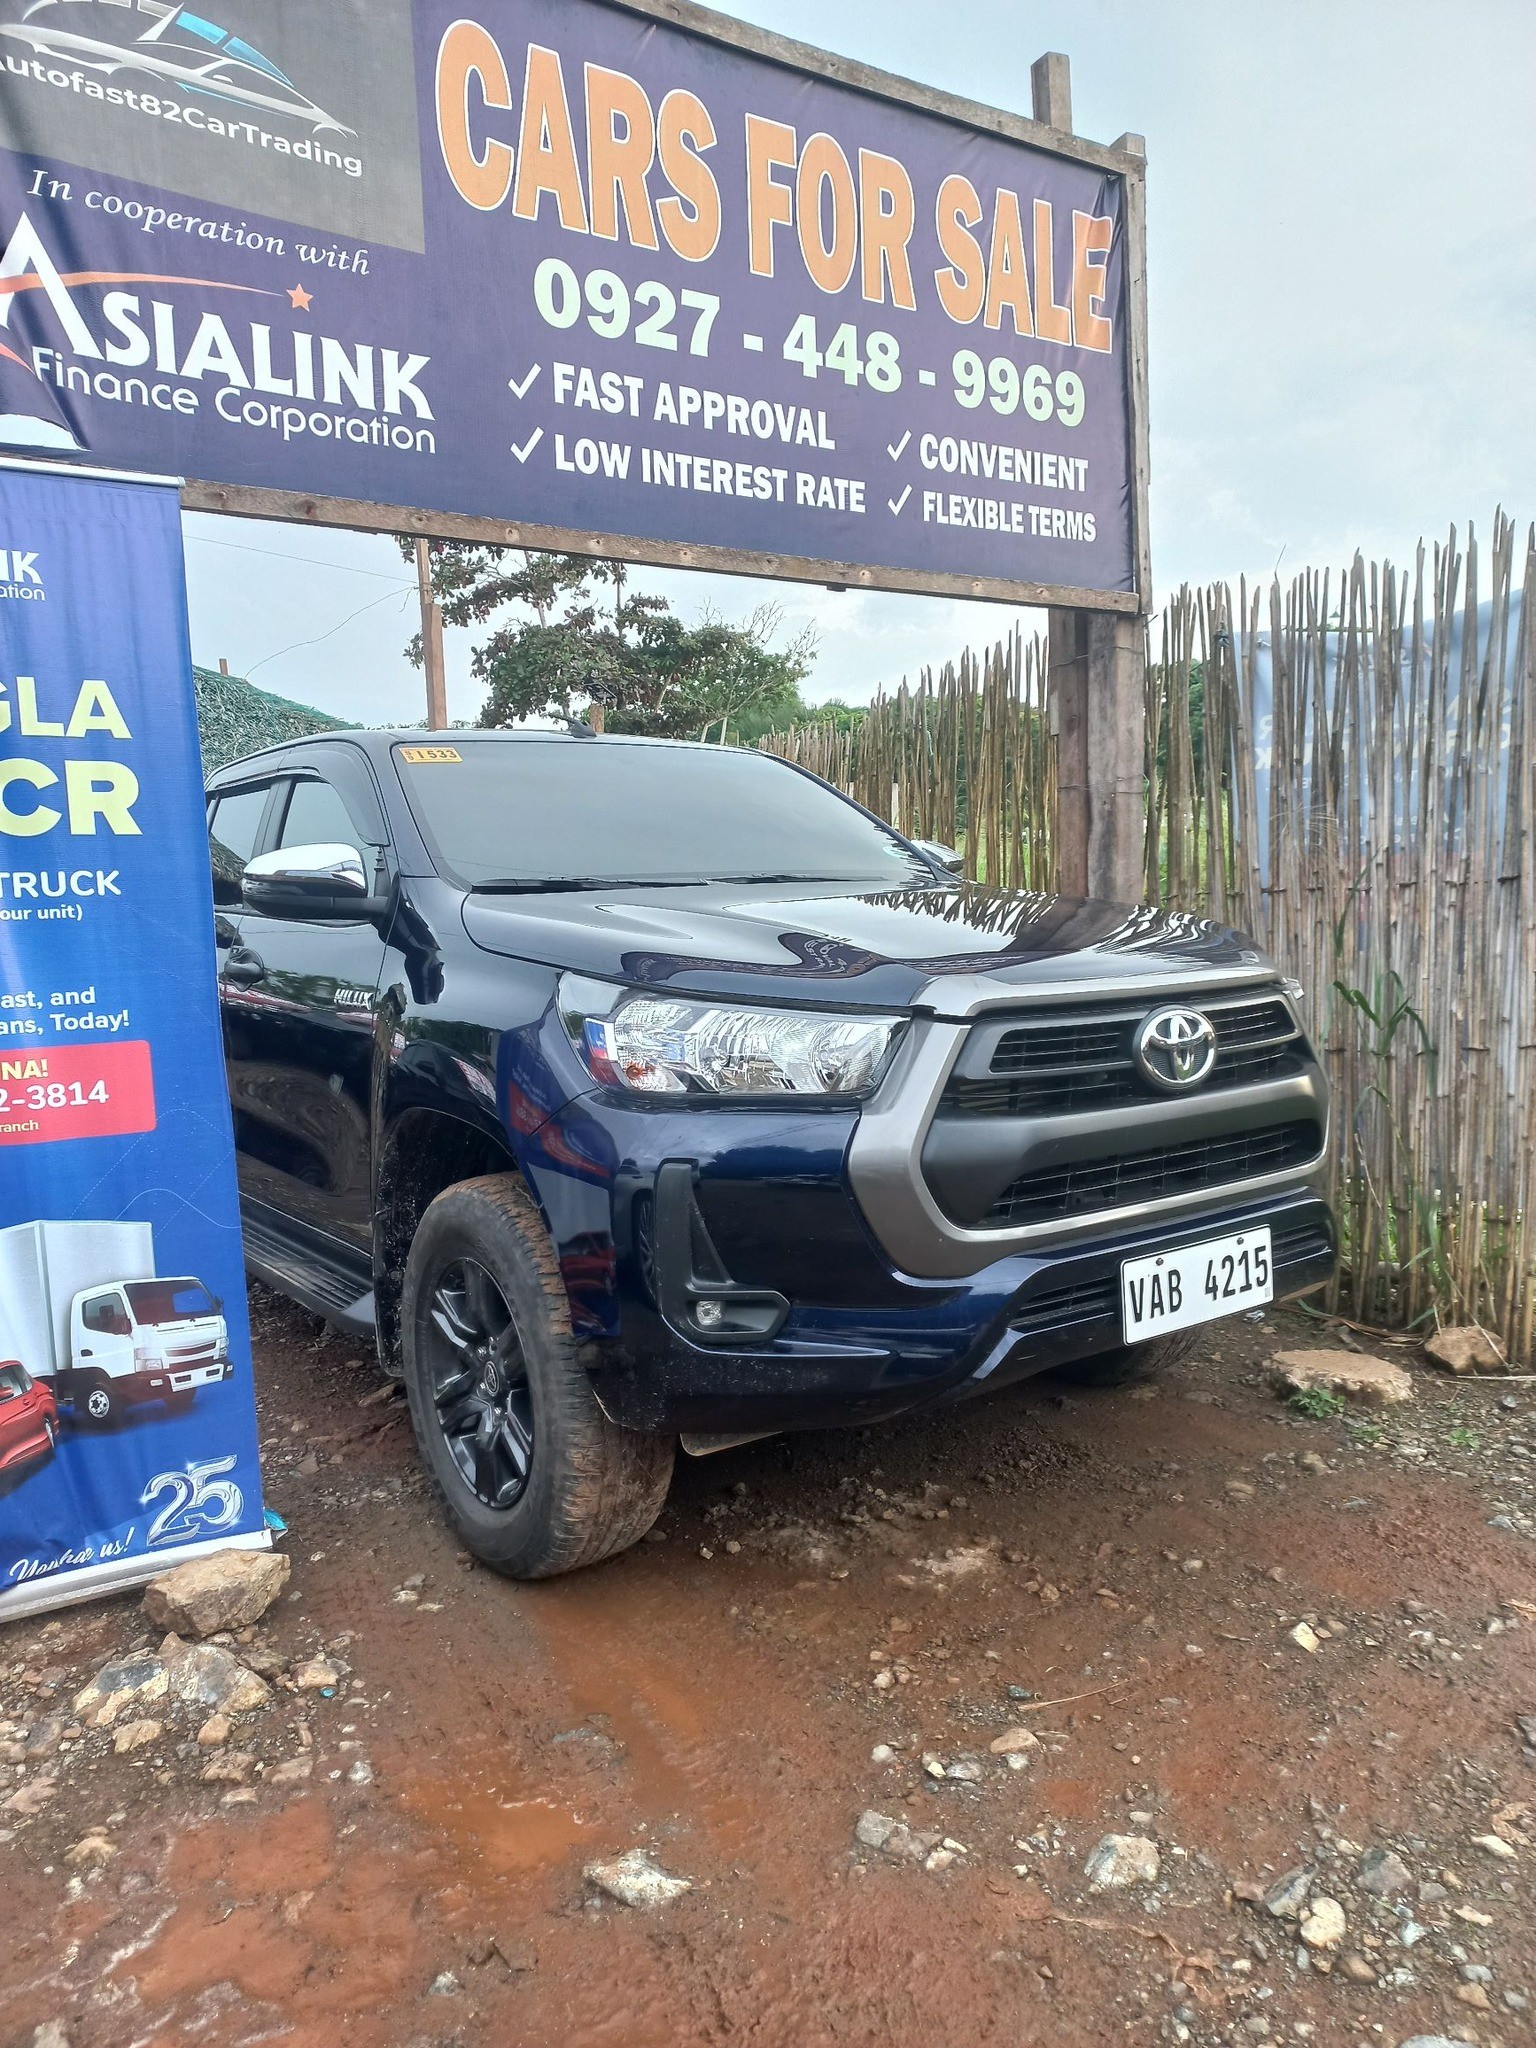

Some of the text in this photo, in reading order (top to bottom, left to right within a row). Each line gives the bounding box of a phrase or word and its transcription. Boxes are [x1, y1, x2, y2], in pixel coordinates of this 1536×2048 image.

[26, 169, 370, 276] In cooperation with
[435, 19, 1113, 354] CARS FOR SALE
[0, 210, 436, 421] ASIALINK
[534, 257, 721, 358] 0927
[782, 313, 902, 394] 448
[952, 349, 1086, 427] 9969
[31, 346, 437, 454] Finance Corporation
[553, 361, 836, 450] FAST APPROVAL
[554, 433, 867, 514] LOW INTEREST RATE
[919, 432, 1089, 492] CONVENIENT
[923, 490, 1097, 543] FLEXIBLE TERMS
[37, 903, 83, 921] unit)
[49, 1009, 130, 1032] Today!
[50, 986, 97, 1007] and
[0, 1058, 49, 1081] NA!
[1129, 1244, 1269, 1324] VAB 4215
[142, 1454, 245, 1547] 25
